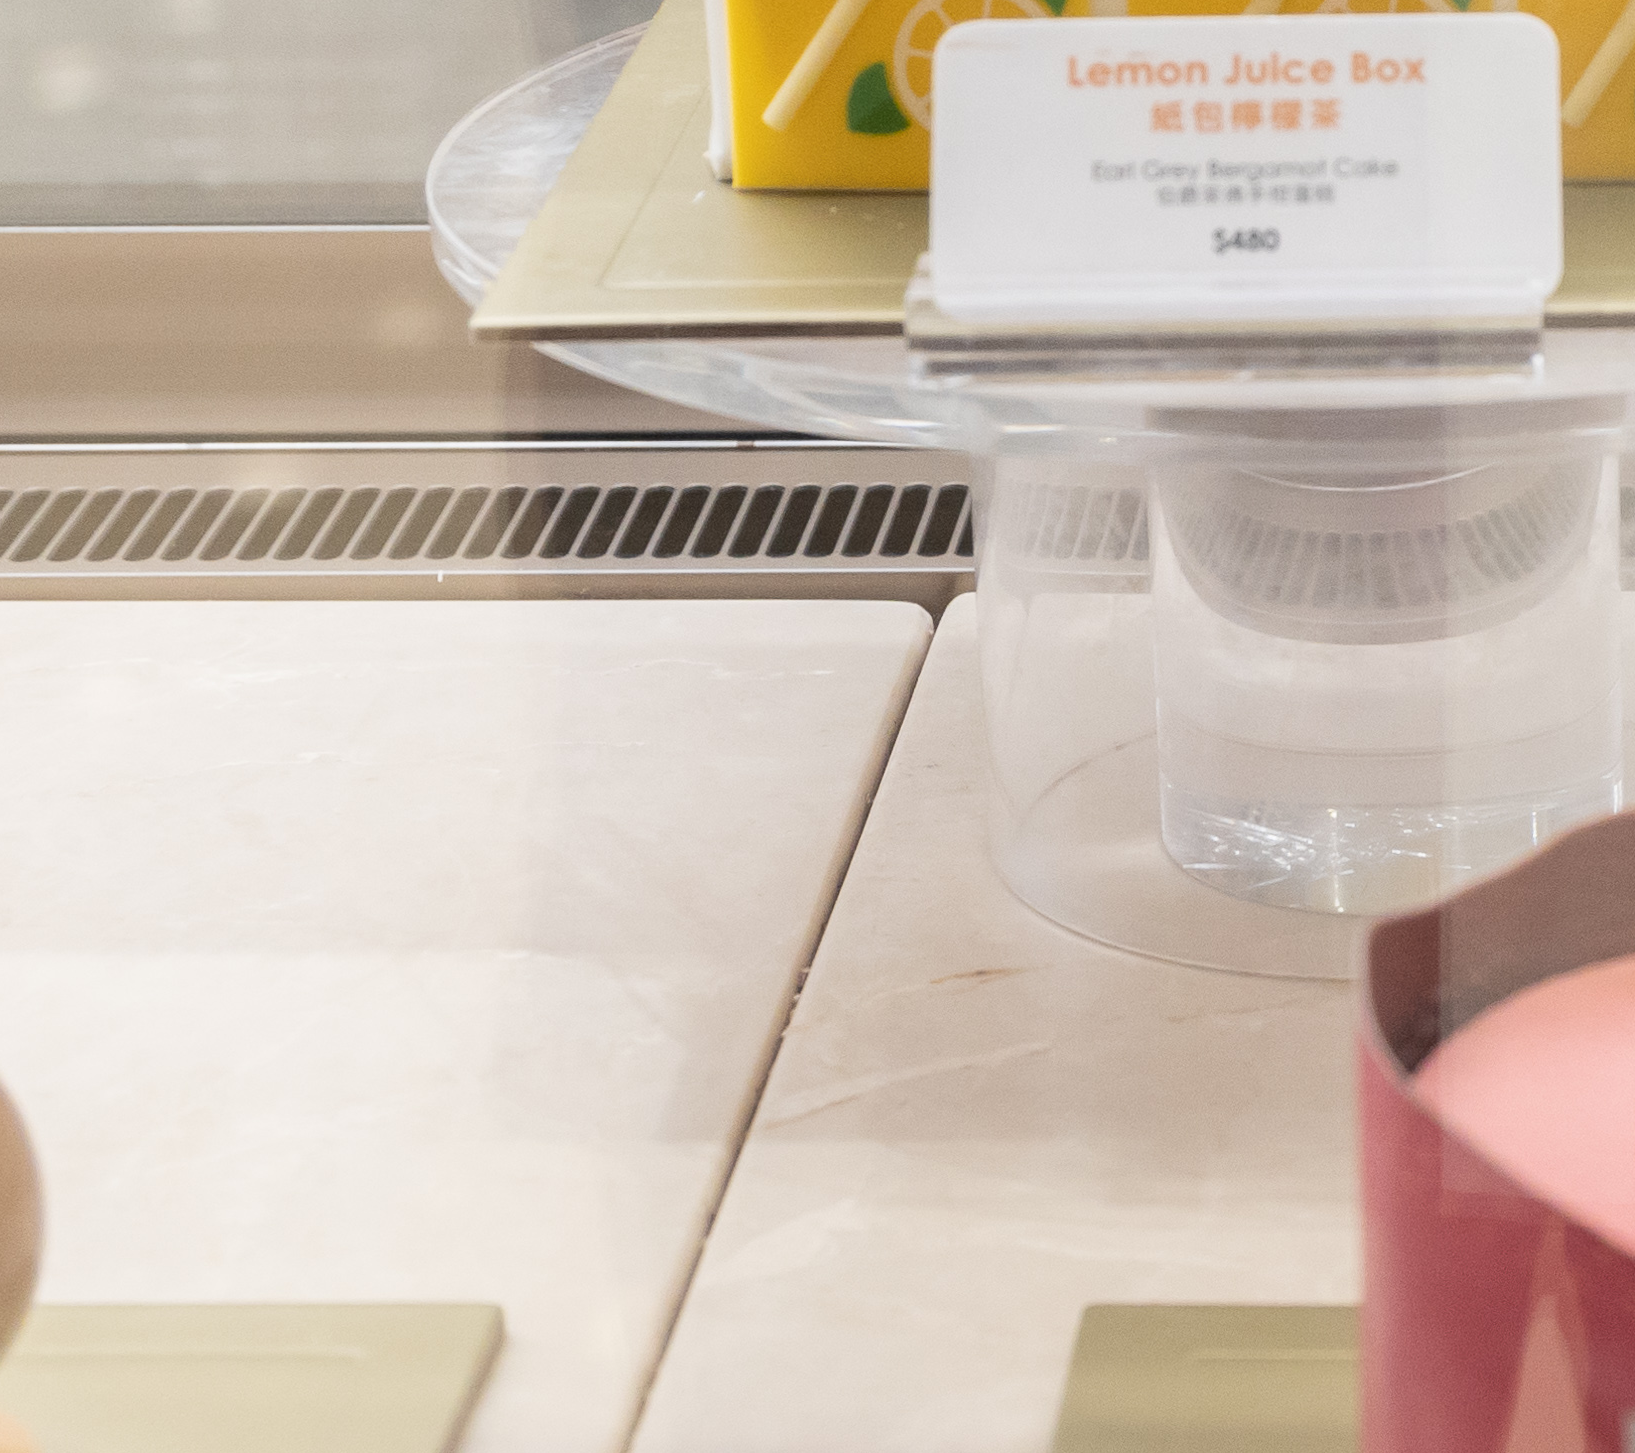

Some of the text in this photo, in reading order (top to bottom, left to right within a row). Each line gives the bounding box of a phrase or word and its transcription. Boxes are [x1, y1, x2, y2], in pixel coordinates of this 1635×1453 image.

[1066, 50, 1426, 89] Lemon Juice Box
[1090, 157, 1400, 186] Earl Grey Bergamot Cake
